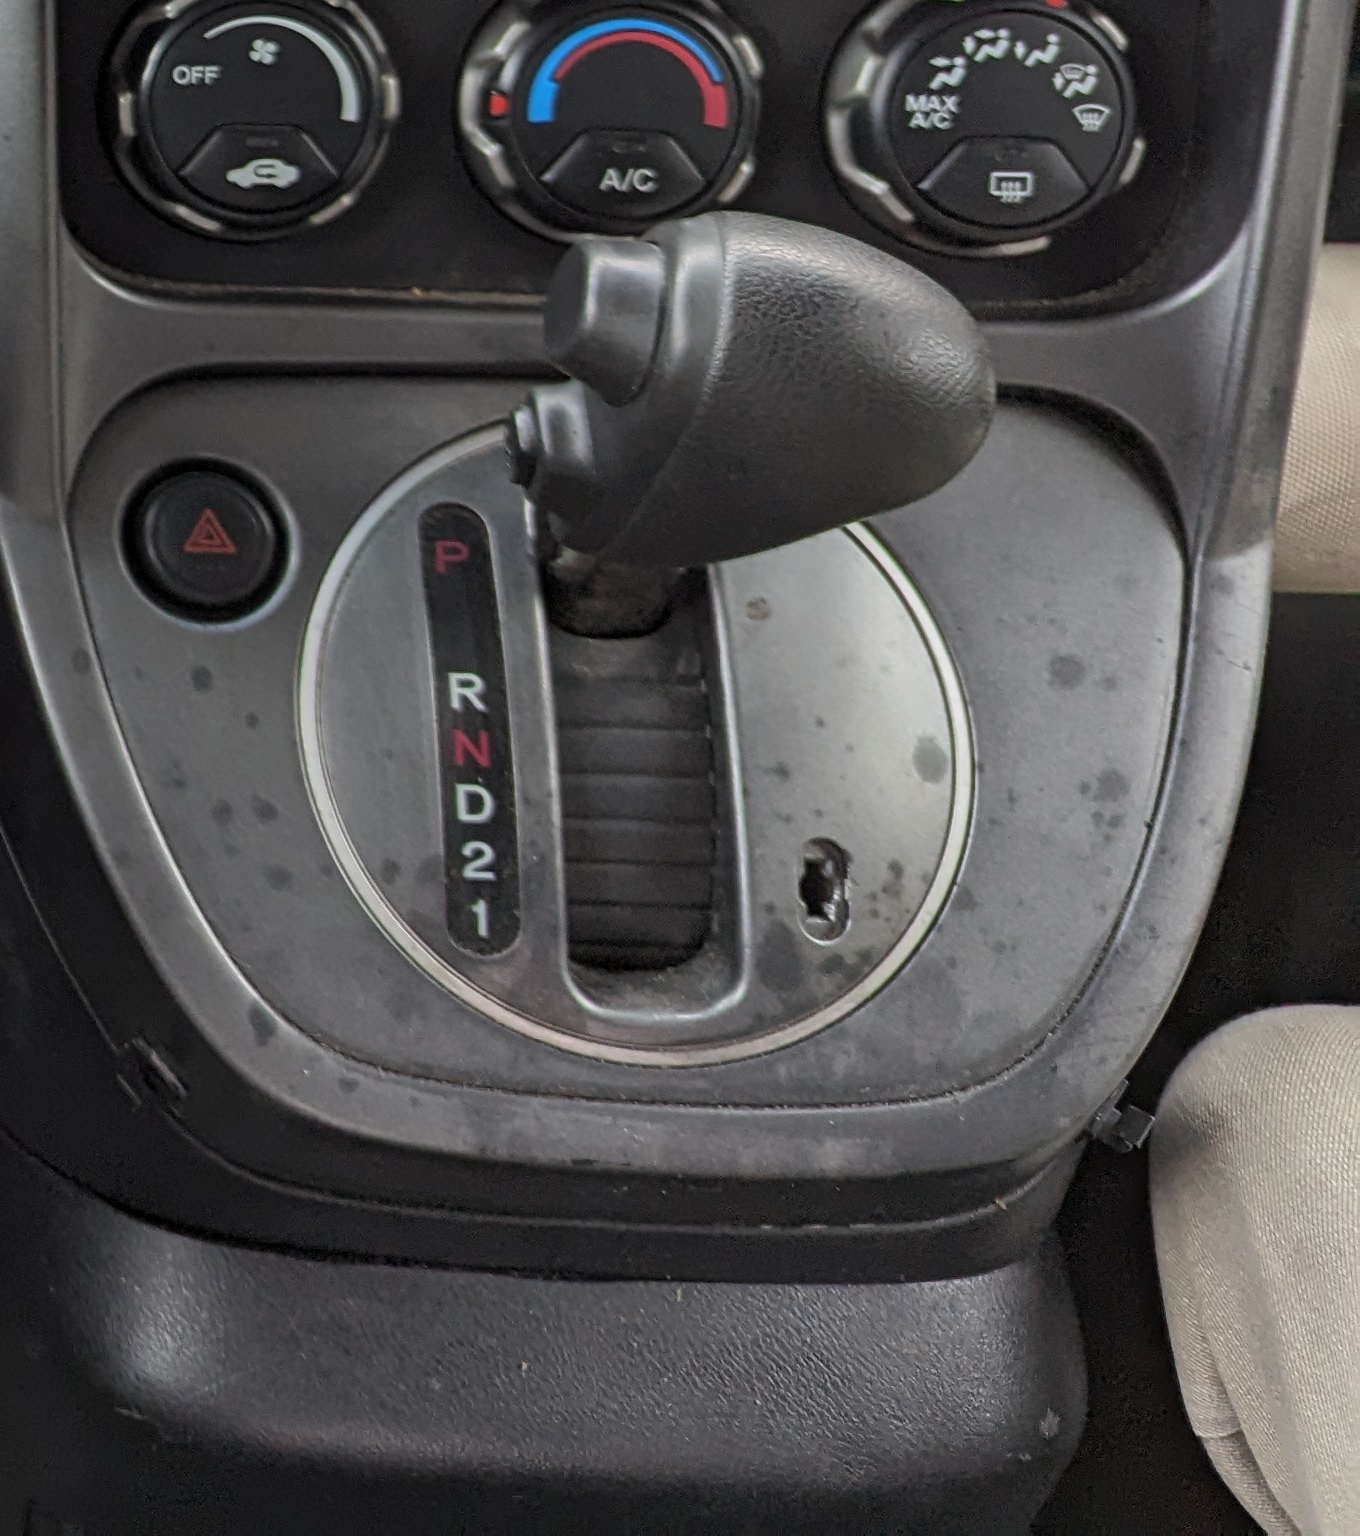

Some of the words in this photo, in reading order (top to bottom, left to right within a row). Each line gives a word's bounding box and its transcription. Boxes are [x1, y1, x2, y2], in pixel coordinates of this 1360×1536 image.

[172, 65, 222, 86] OFF
[904, 94, 961, 113] MAX
[908, 113, 954, 129] A/C
[598, 168, 659, 193] A/C
[434, 540, 470, 572] P
[447, 671, 487, 712] R
[451, 728, 490, 768] N
[455, 784, 495, 825] D
[461, 840, 495, 880] 2
[471, 898, 490, 939] 1
